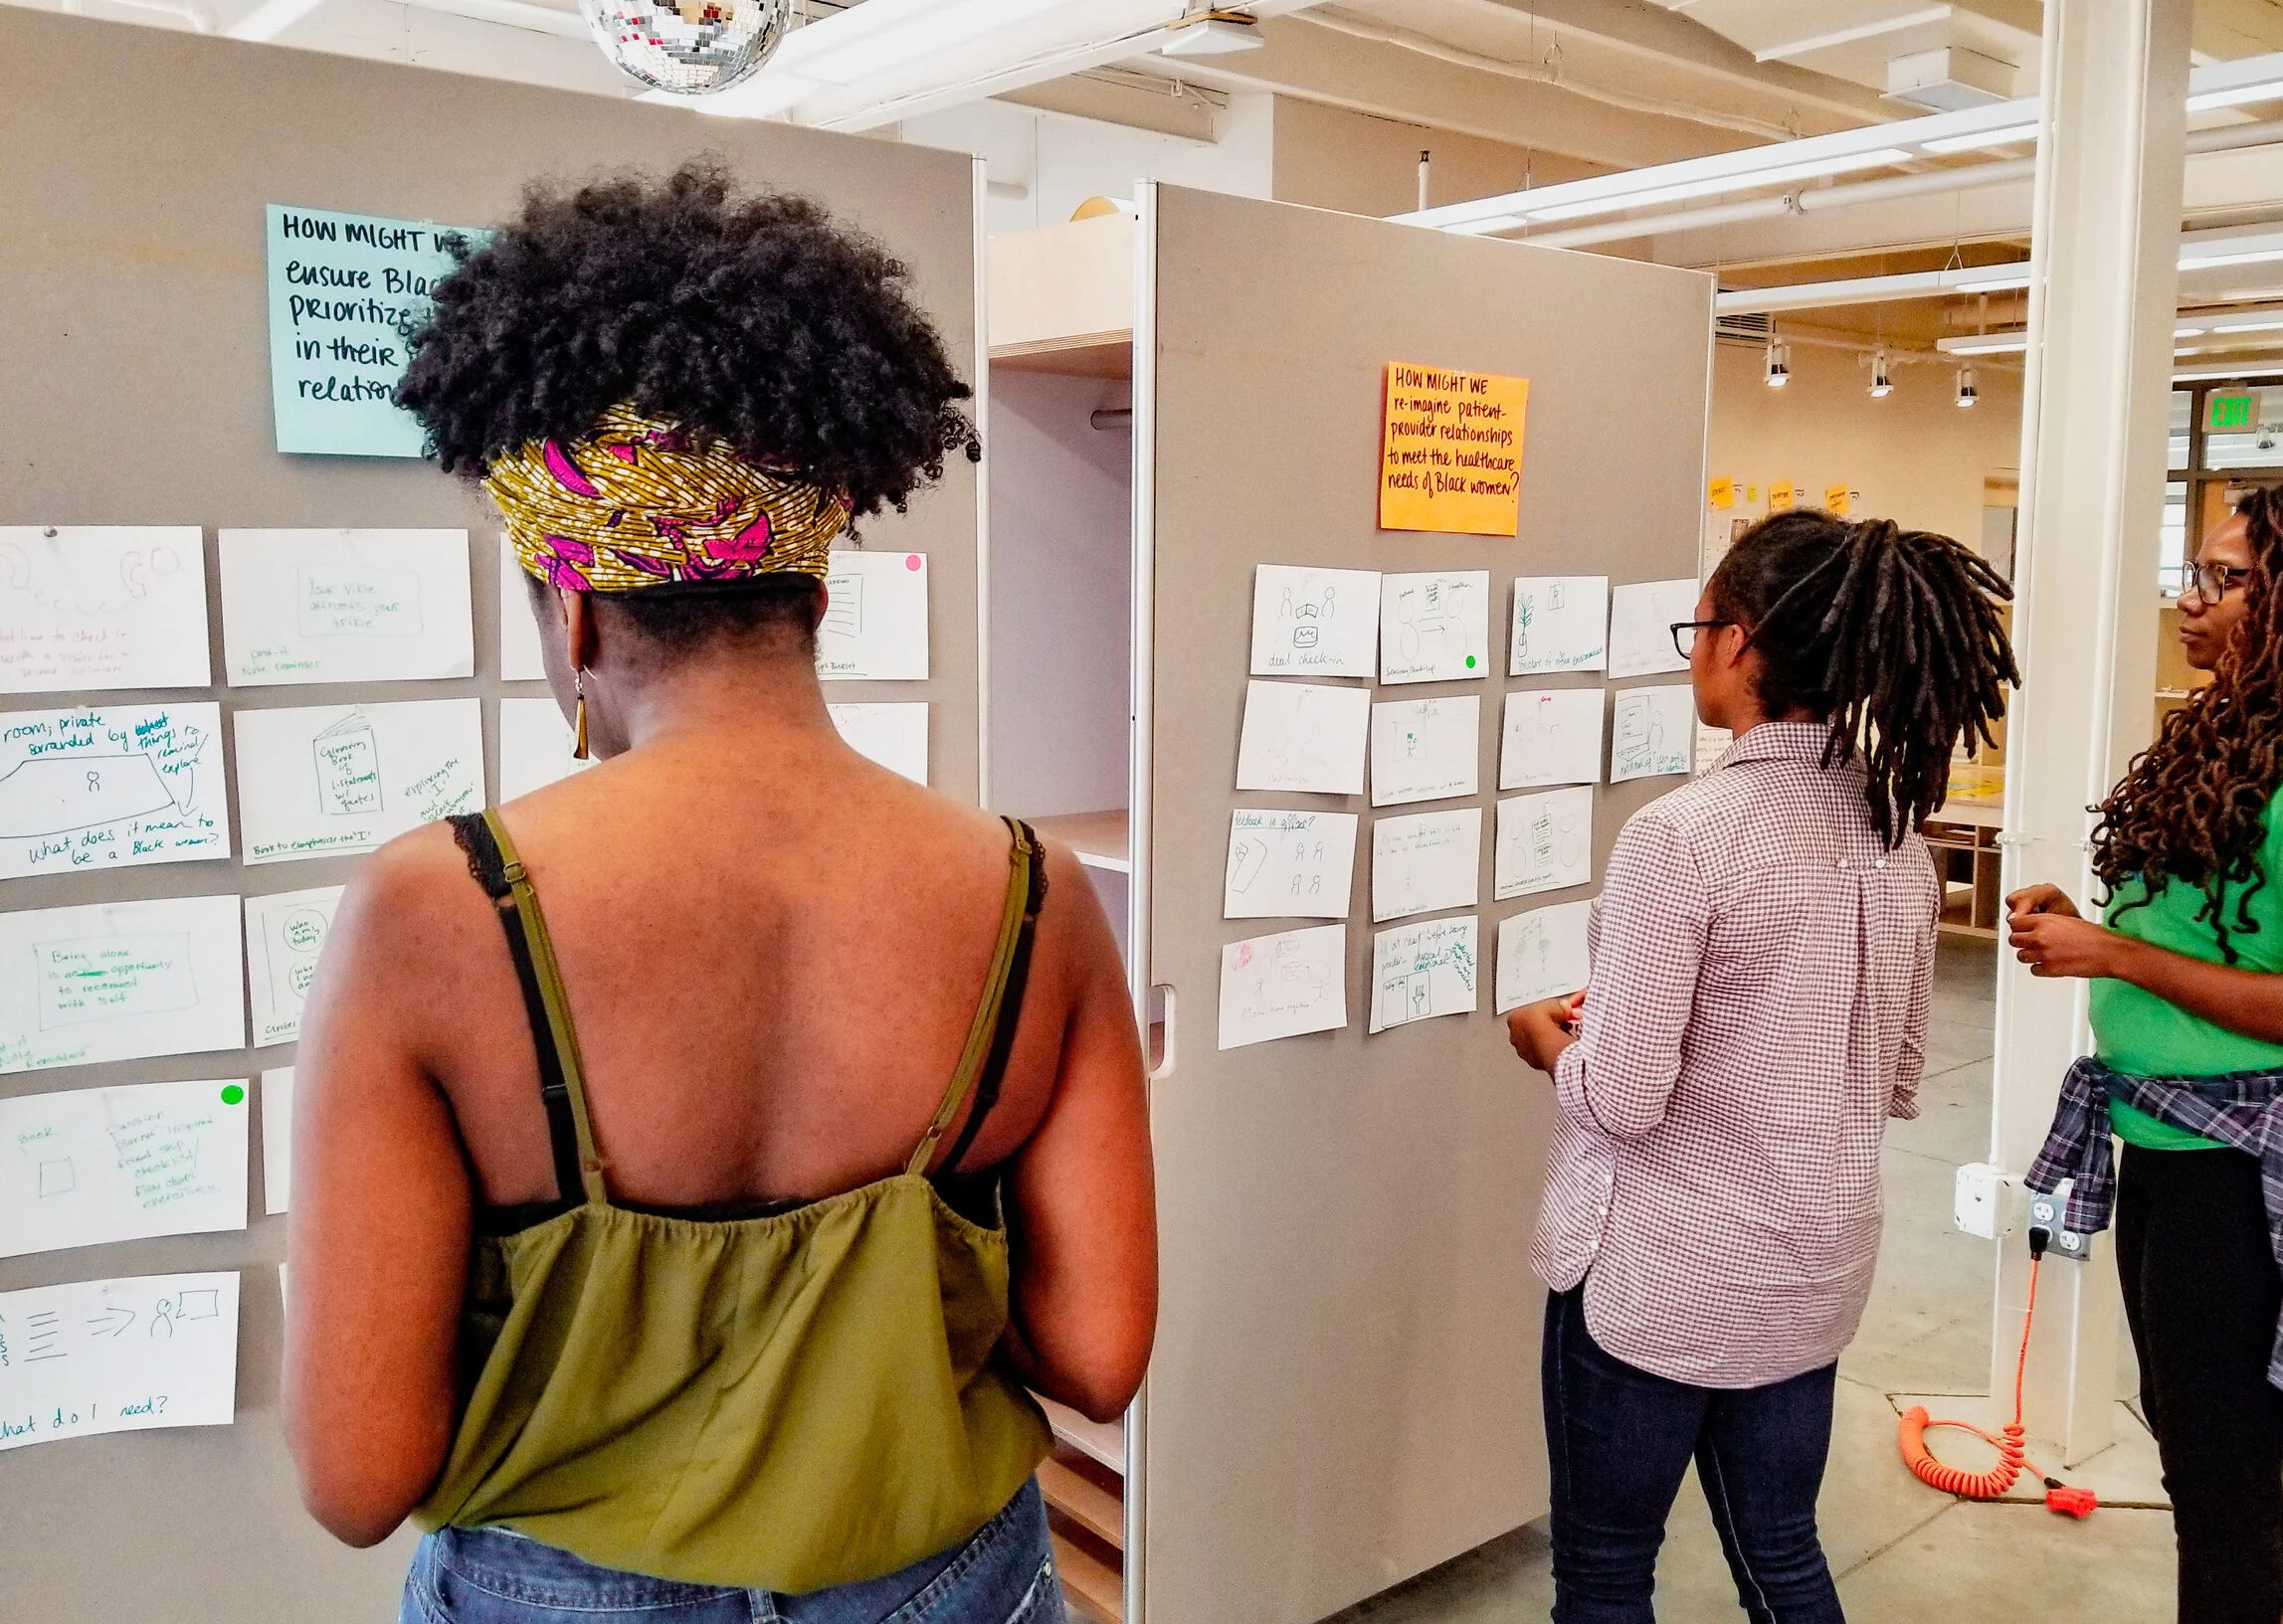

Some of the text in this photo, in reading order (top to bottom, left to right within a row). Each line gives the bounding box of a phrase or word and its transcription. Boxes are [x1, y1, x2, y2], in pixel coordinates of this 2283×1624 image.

[283, 213, 336, 243] HOW
[344, 223, 426, 252] MIGHT
[285, 261, 440, 296] ensure Blac
[295, 332, 321, 360] in
[297, 375, 396, 403] relation
[1396, 367, 1489, 395] HOW MIGHT WE
[1394, 396, 1507, 425] re-imagine patient-
[2210, 397, 2252, 427] EXIT
[1391, 418, 1513, 449] provider relationships
[1387, 447, 1515, 471] to meet the healthcare
[1388, 470, 1520, 503] needs of Black women?
[1297, 651, 1346, 666] check-in
[59, 711, 106, 737] private
[108, 728, 129, 752] by
[82, 830, 115, 847] does
[127, 820, 139, 837] it
[145, 821, 193, 833] mean
[199, 812, 215, 828] to
[72, 848, 94, 865] be
[108, 850, 118, 860] a
[132, 838, 164, 856] Black
[0, 1414, 36, 1439] hat
[119, 1395, 168, 1417] need?
